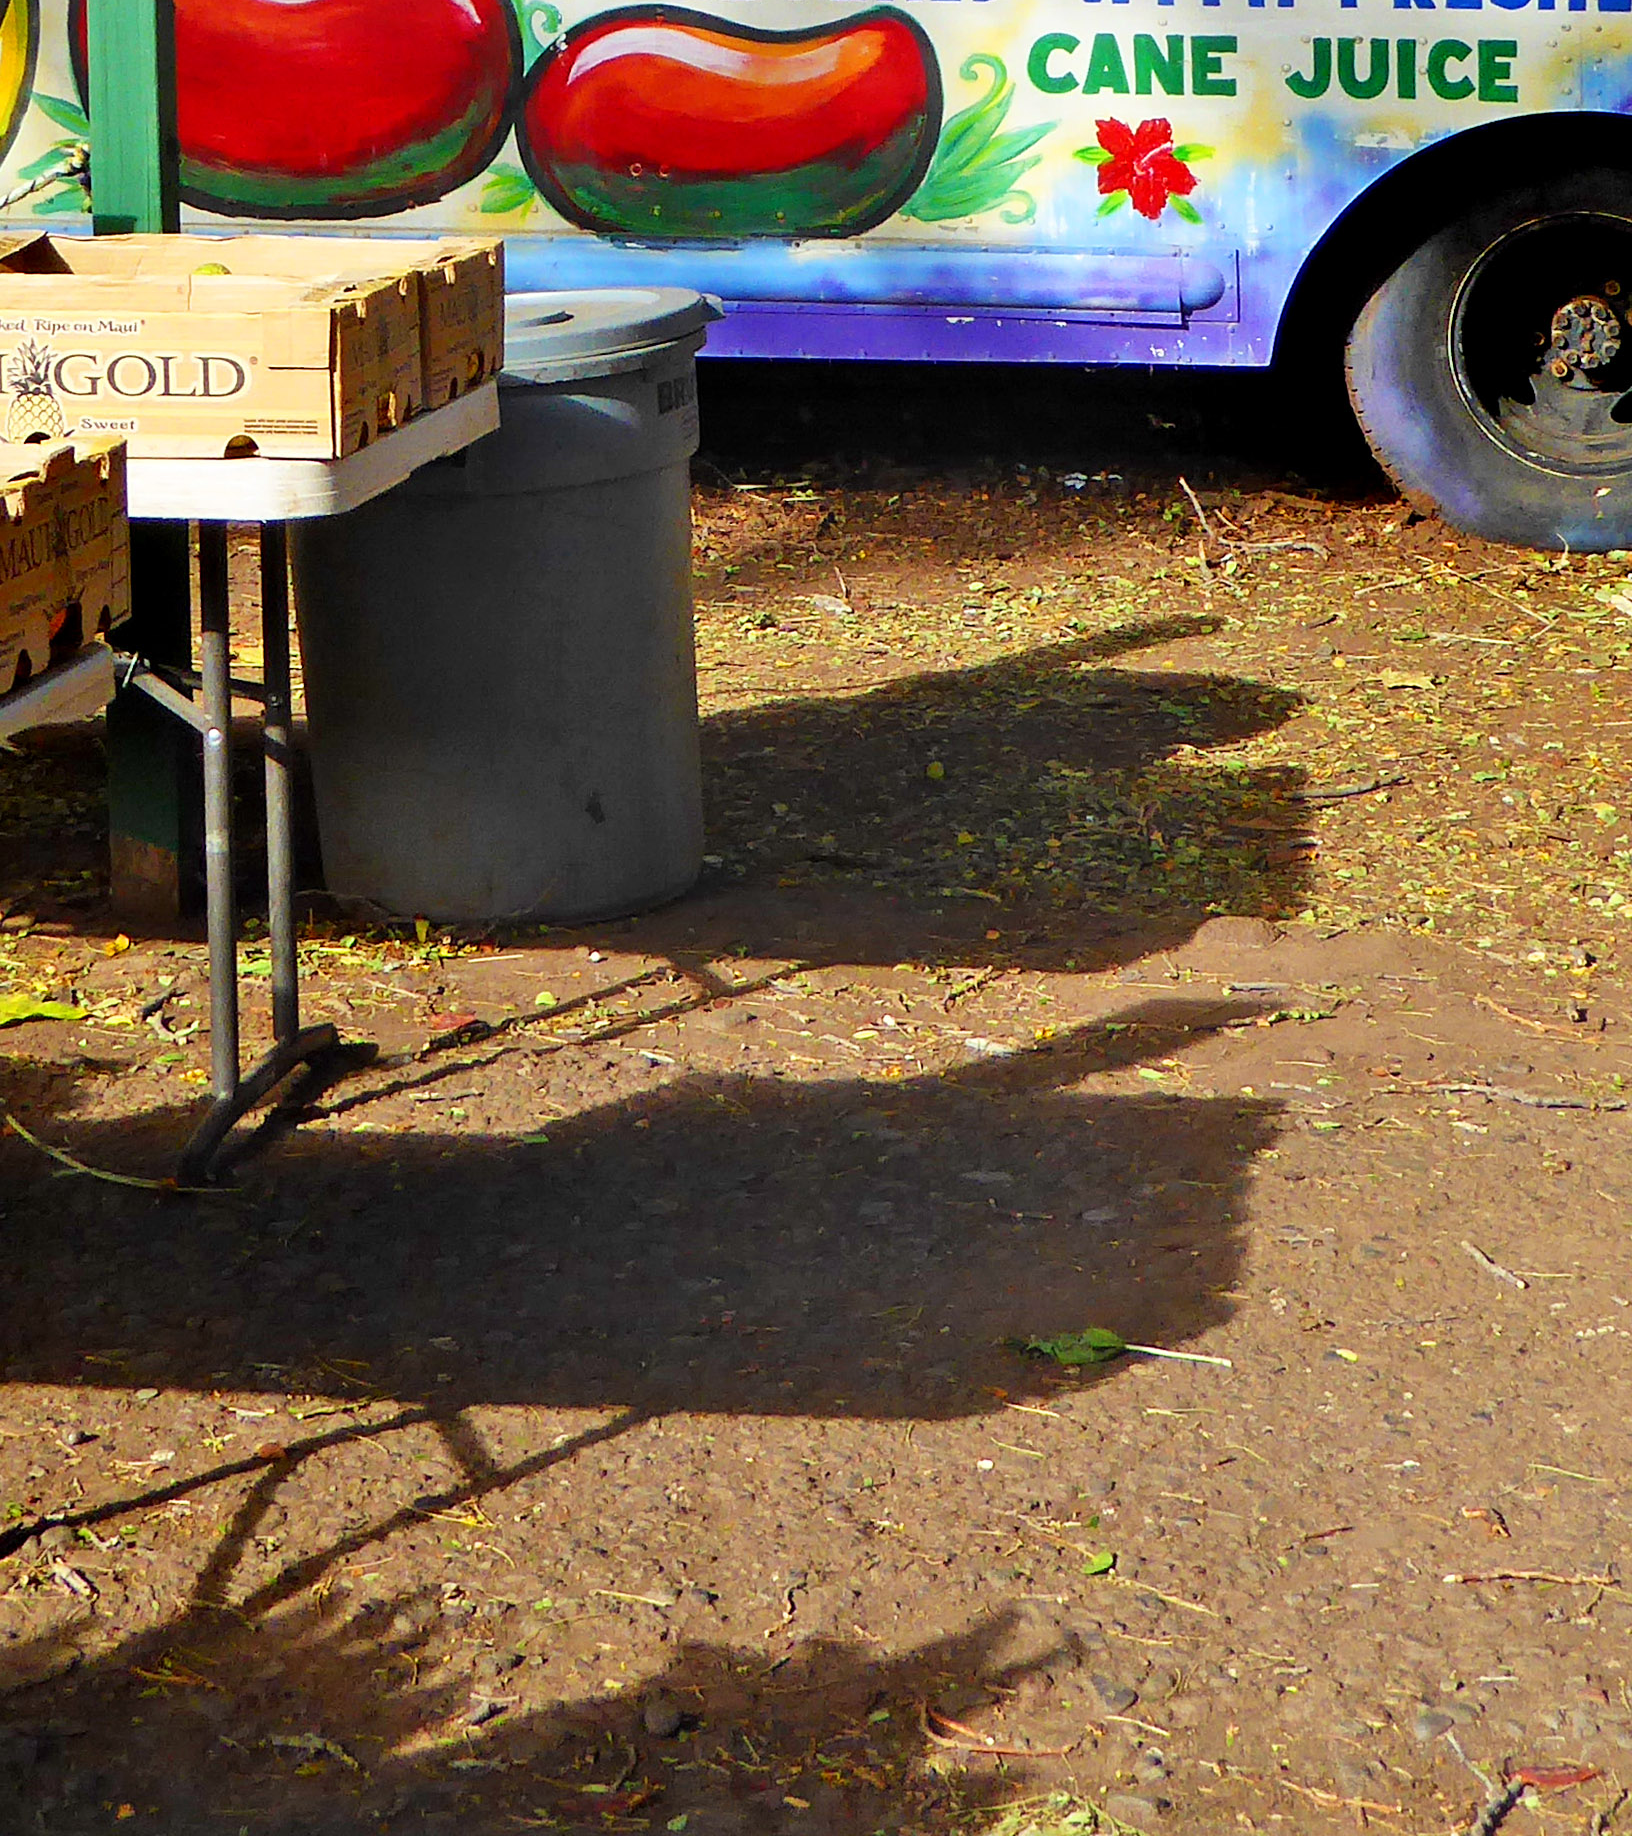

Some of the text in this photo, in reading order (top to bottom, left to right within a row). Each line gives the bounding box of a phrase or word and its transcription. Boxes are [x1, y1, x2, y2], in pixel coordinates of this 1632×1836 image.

[1027, 32, 1518, 103] CANE JUICE
[34, 319, 70, 335] Ripe
[73, 323, 94, 333] on
[96, 320, 140, 334] Maui
[54, 354, 246, 398] GOLD
[81, 417, 137, 431] Sweet
